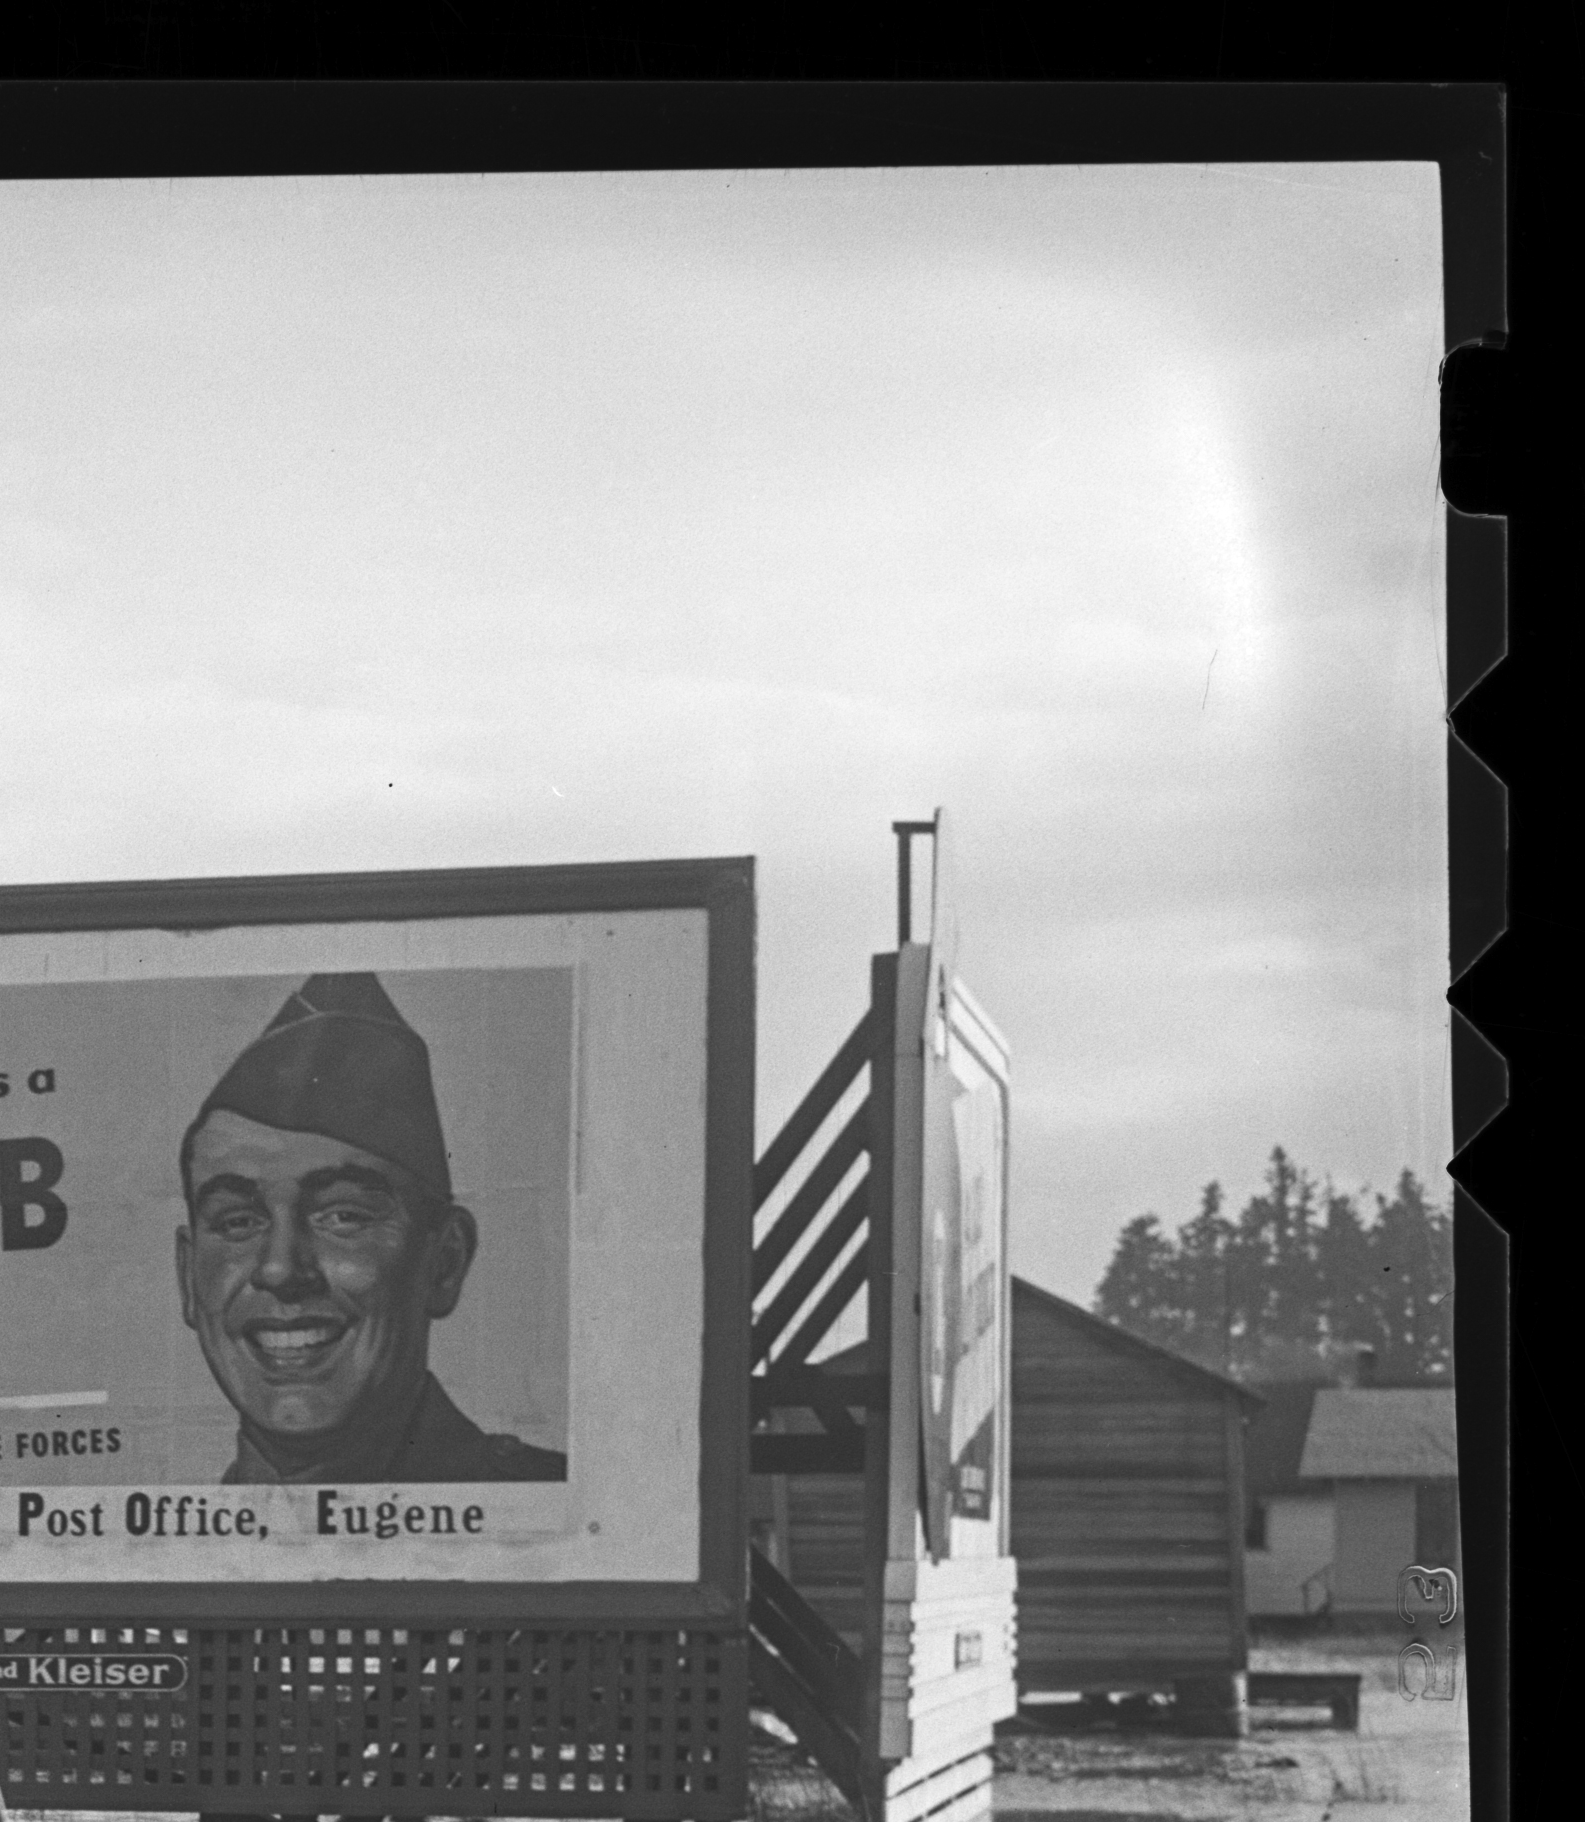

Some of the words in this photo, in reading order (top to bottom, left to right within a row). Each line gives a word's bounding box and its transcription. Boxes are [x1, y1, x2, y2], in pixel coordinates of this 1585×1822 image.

[27, 1068, 56, 1095] a
[15, 1427, 121, 1459] FORCES
[18, 1492, 104, 1537] Post
[125, 1491, 269, 1540] Office,
[316, 1489, 484, 1540] Eugene
[26, 1654, 170, 1685] Kleiser
